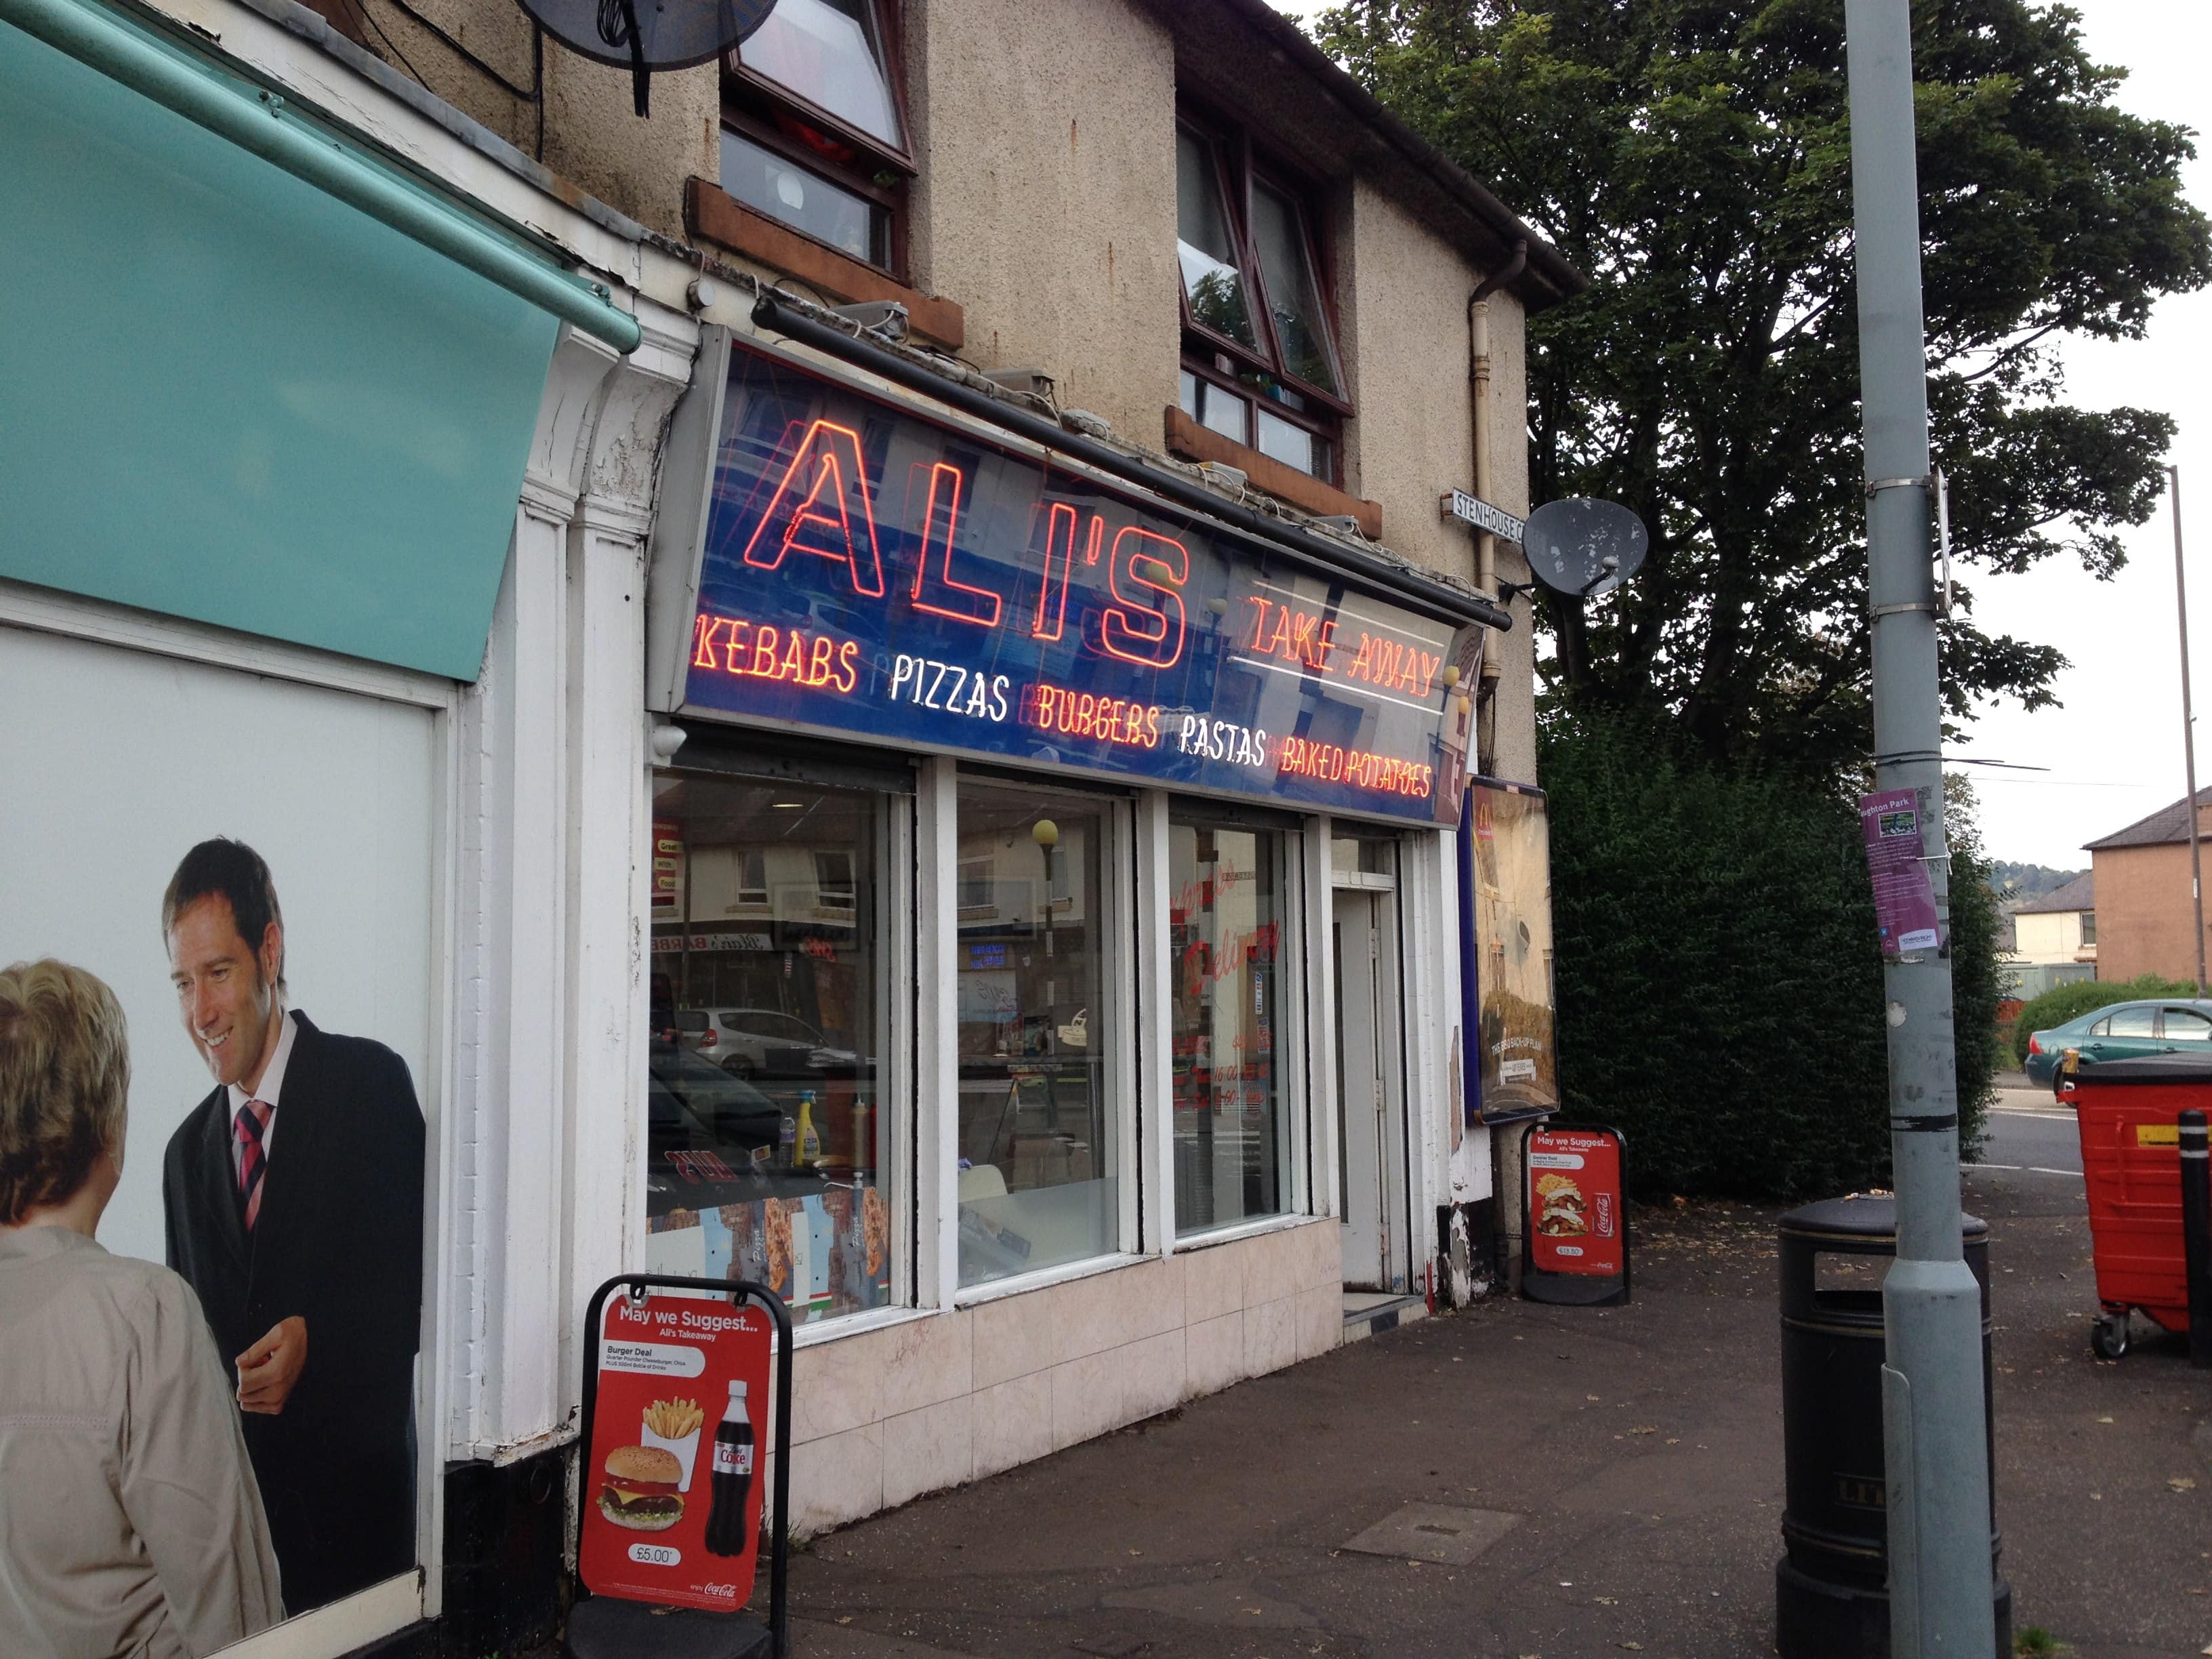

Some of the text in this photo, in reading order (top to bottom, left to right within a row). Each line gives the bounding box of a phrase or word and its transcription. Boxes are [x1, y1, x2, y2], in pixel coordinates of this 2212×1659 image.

[1456, 494, 1515, 539] STENHOUSE
[743, 419, 1189, 668] ALI'S
[694, 613, 859, 693] KEBABS
[1250, 596, 1441, 697] TAKE AWAY
[890, 654, 1009, 722] PIZZAS
[1038, 684, 1159, 748] BURGERS
[1178, 715, 1267, 767] PASTAS
[1282, 737, 1432, 798] BAKED POTATOES
[1889, 798, 1909, 808] Park
[1537, 1136, 1554, 1145] May
[1570, 1138, 1611, 1147] Suggest...
[620, 1305, 758, 1332] May we Suggest...
[659, 1328, 716, 1343] Ali's Takeaway
[607, 1346, 652, 1356] Burger Deal
[721, 1449, 745, 1464] Coke
